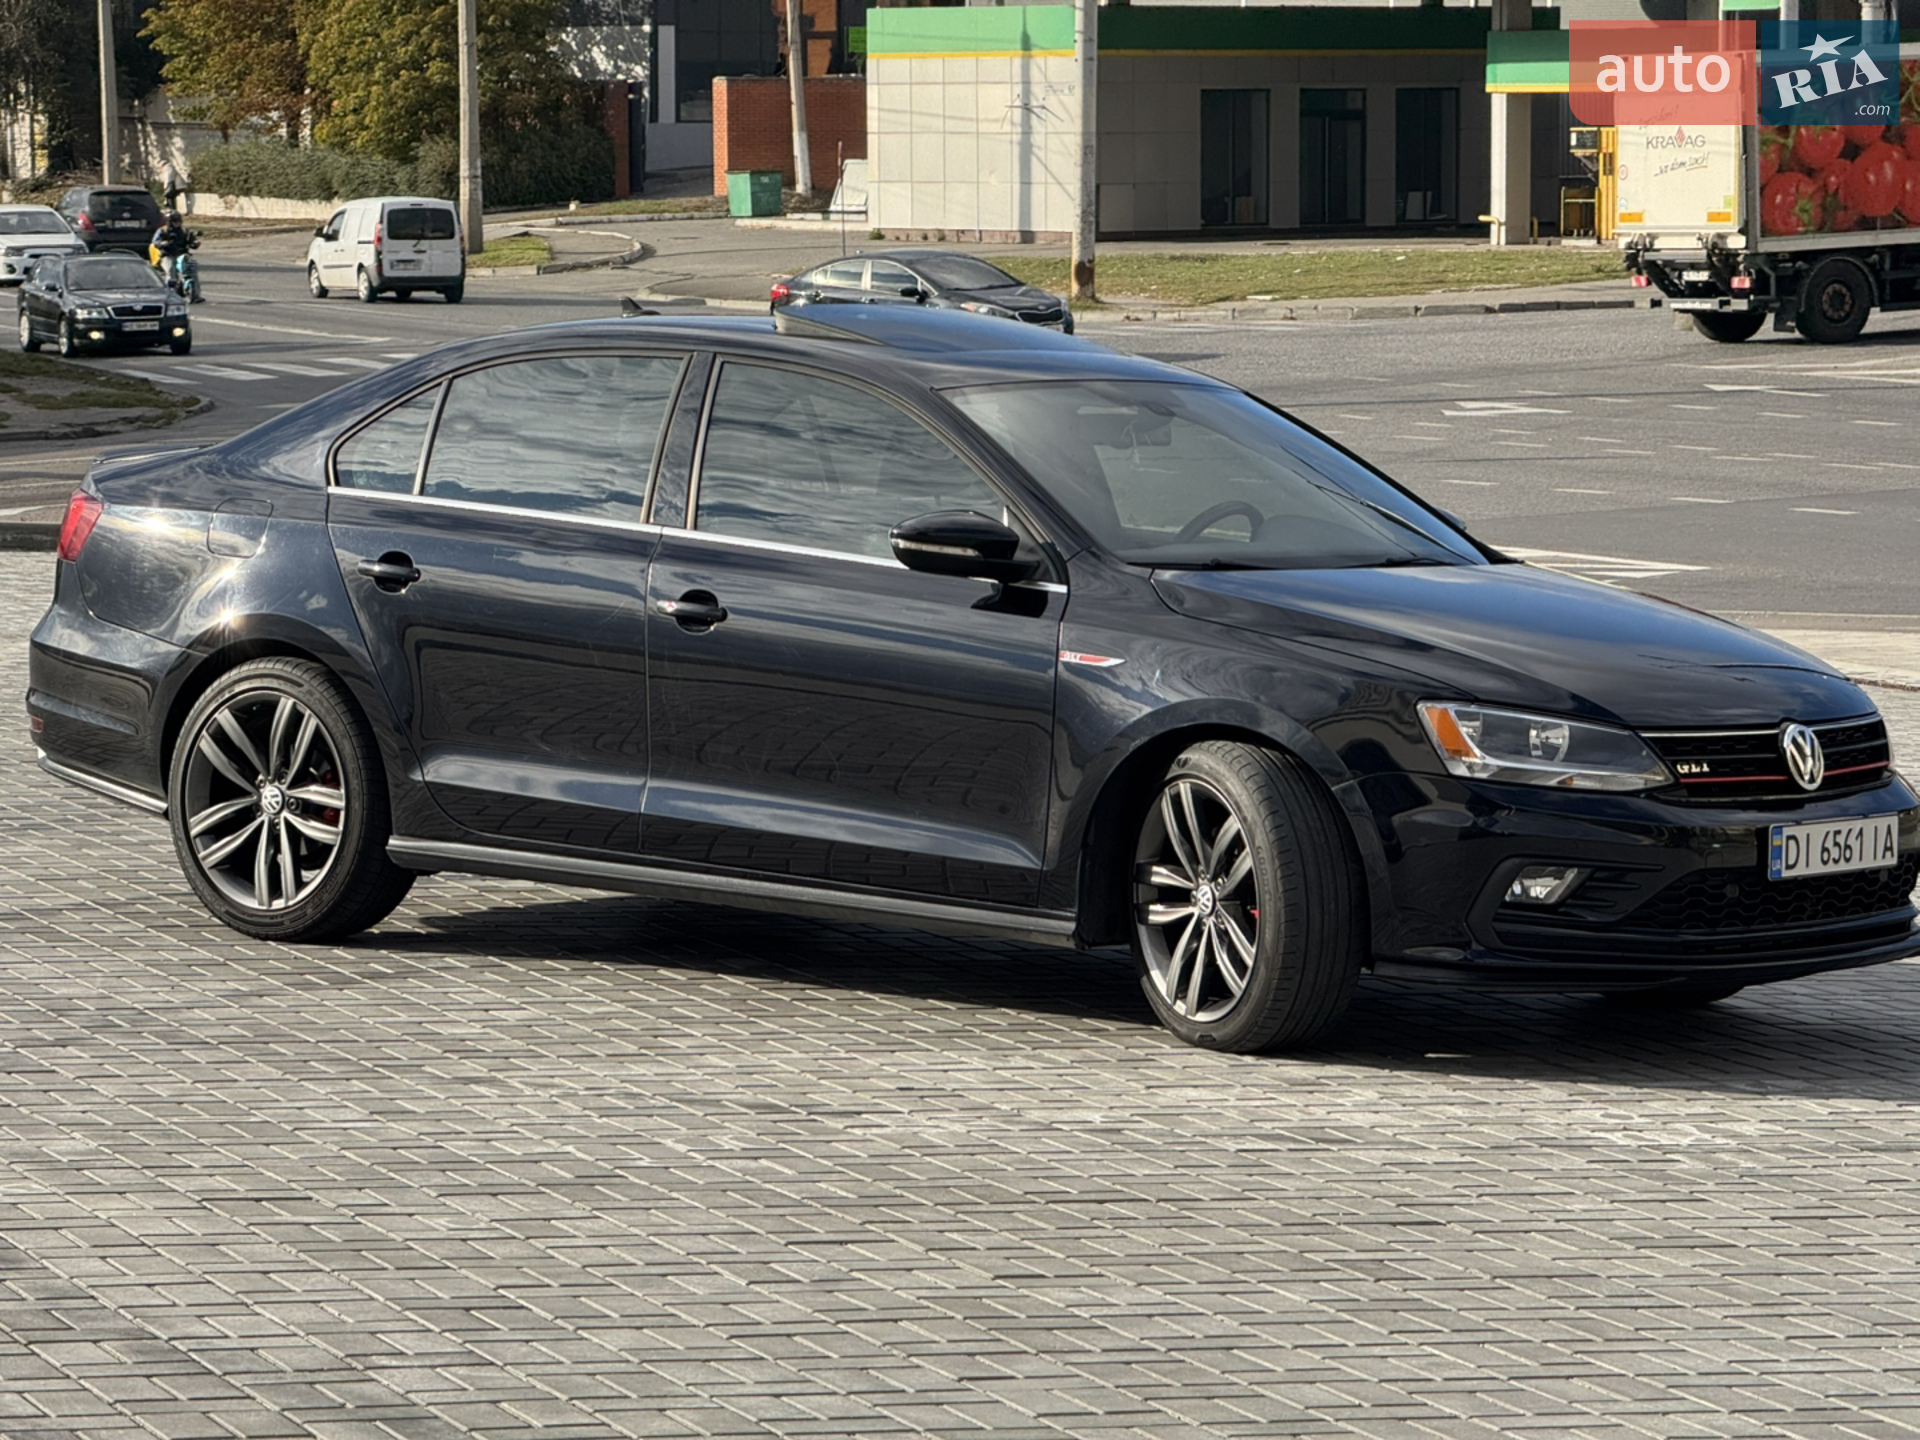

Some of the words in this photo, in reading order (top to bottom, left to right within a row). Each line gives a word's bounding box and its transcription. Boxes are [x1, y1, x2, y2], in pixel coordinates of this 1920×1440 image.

[1646, 134, 1706, 149] KRAVAG
[1676, 761, 1710, 774] GLI
[1784, 833, 1811, 871] DI
[1820, 827, 1864, 866] 6561
[1873, 823, 1895, 860] IA
